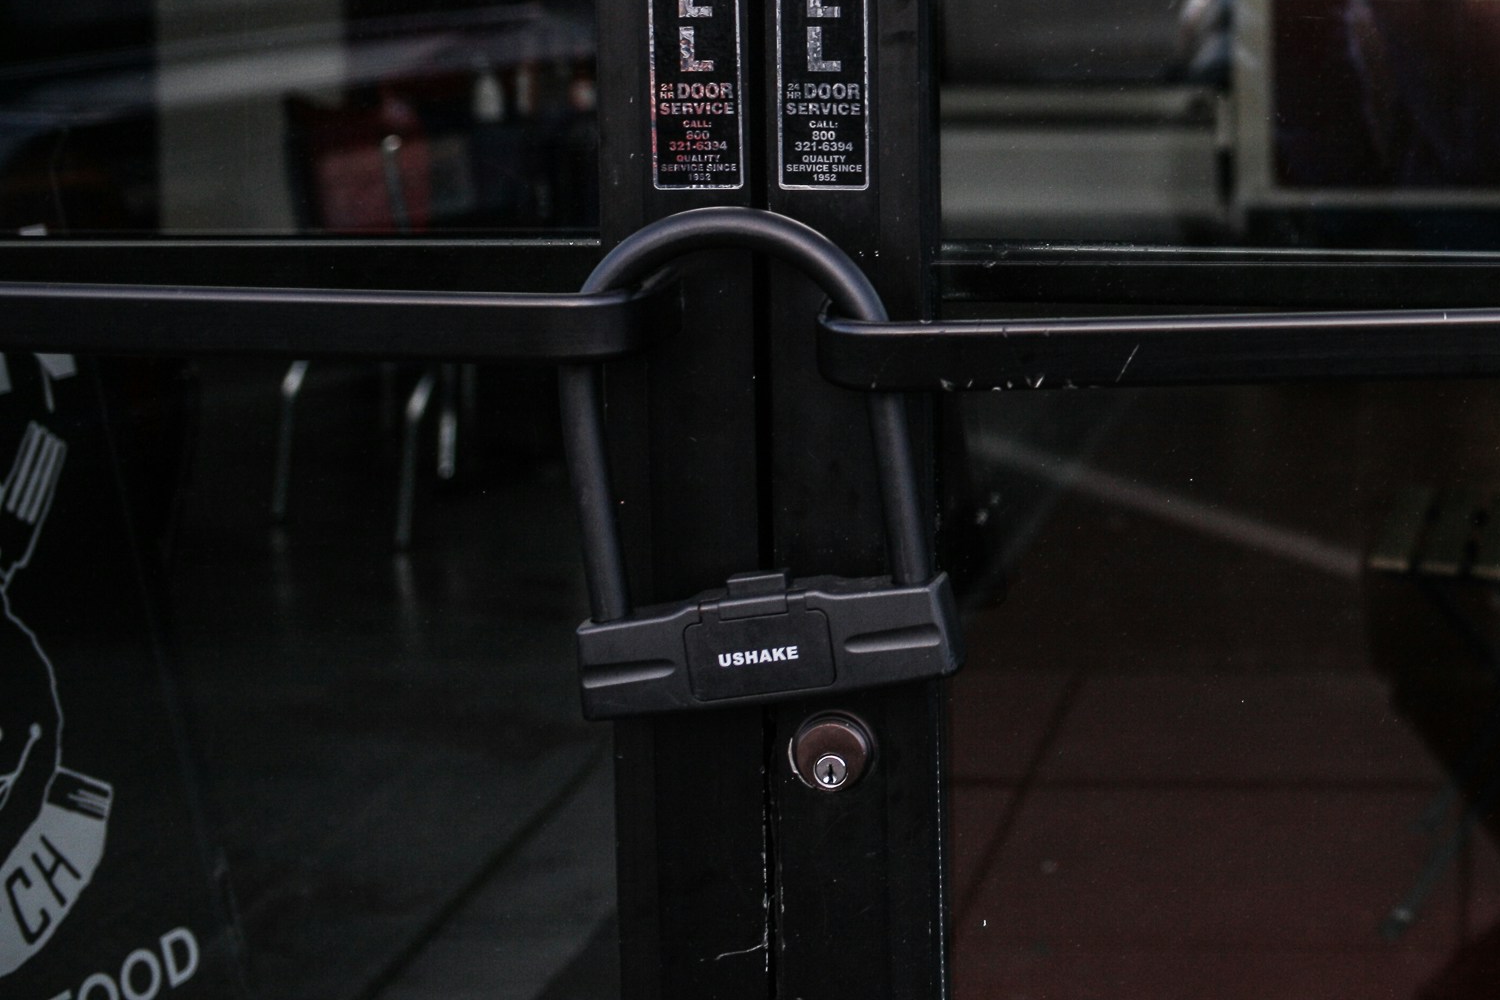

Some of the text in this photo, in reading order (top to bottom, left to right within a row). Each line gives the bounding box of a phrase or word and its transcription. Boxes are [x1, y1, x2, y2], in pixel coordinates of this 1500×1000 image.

[677, 82, 734, 99] DOOR
[786, 91, 802, 99] HR
[804, 82, 861, 100] DOOR
[659, 102, 735, 115] SERVICE
[786, 102, 862, 116] SERVICE
[682, 120, 712, 128] CALL:
[809, 120, 839, 128] CALL:
[685, 130, 710, 140] 800
[811, 130, 836, 141] 800
[794, 141, 854, 152] 321-6394
[802, 154, 847, 164] QUALITY
[660, 163, 737, 172] SERVICE SINCE
[786, 163, 863, 172] SERVICE SINCE
[812, 173, 837, 182] 1952
[717, 645, 799, 668] USHAKE
